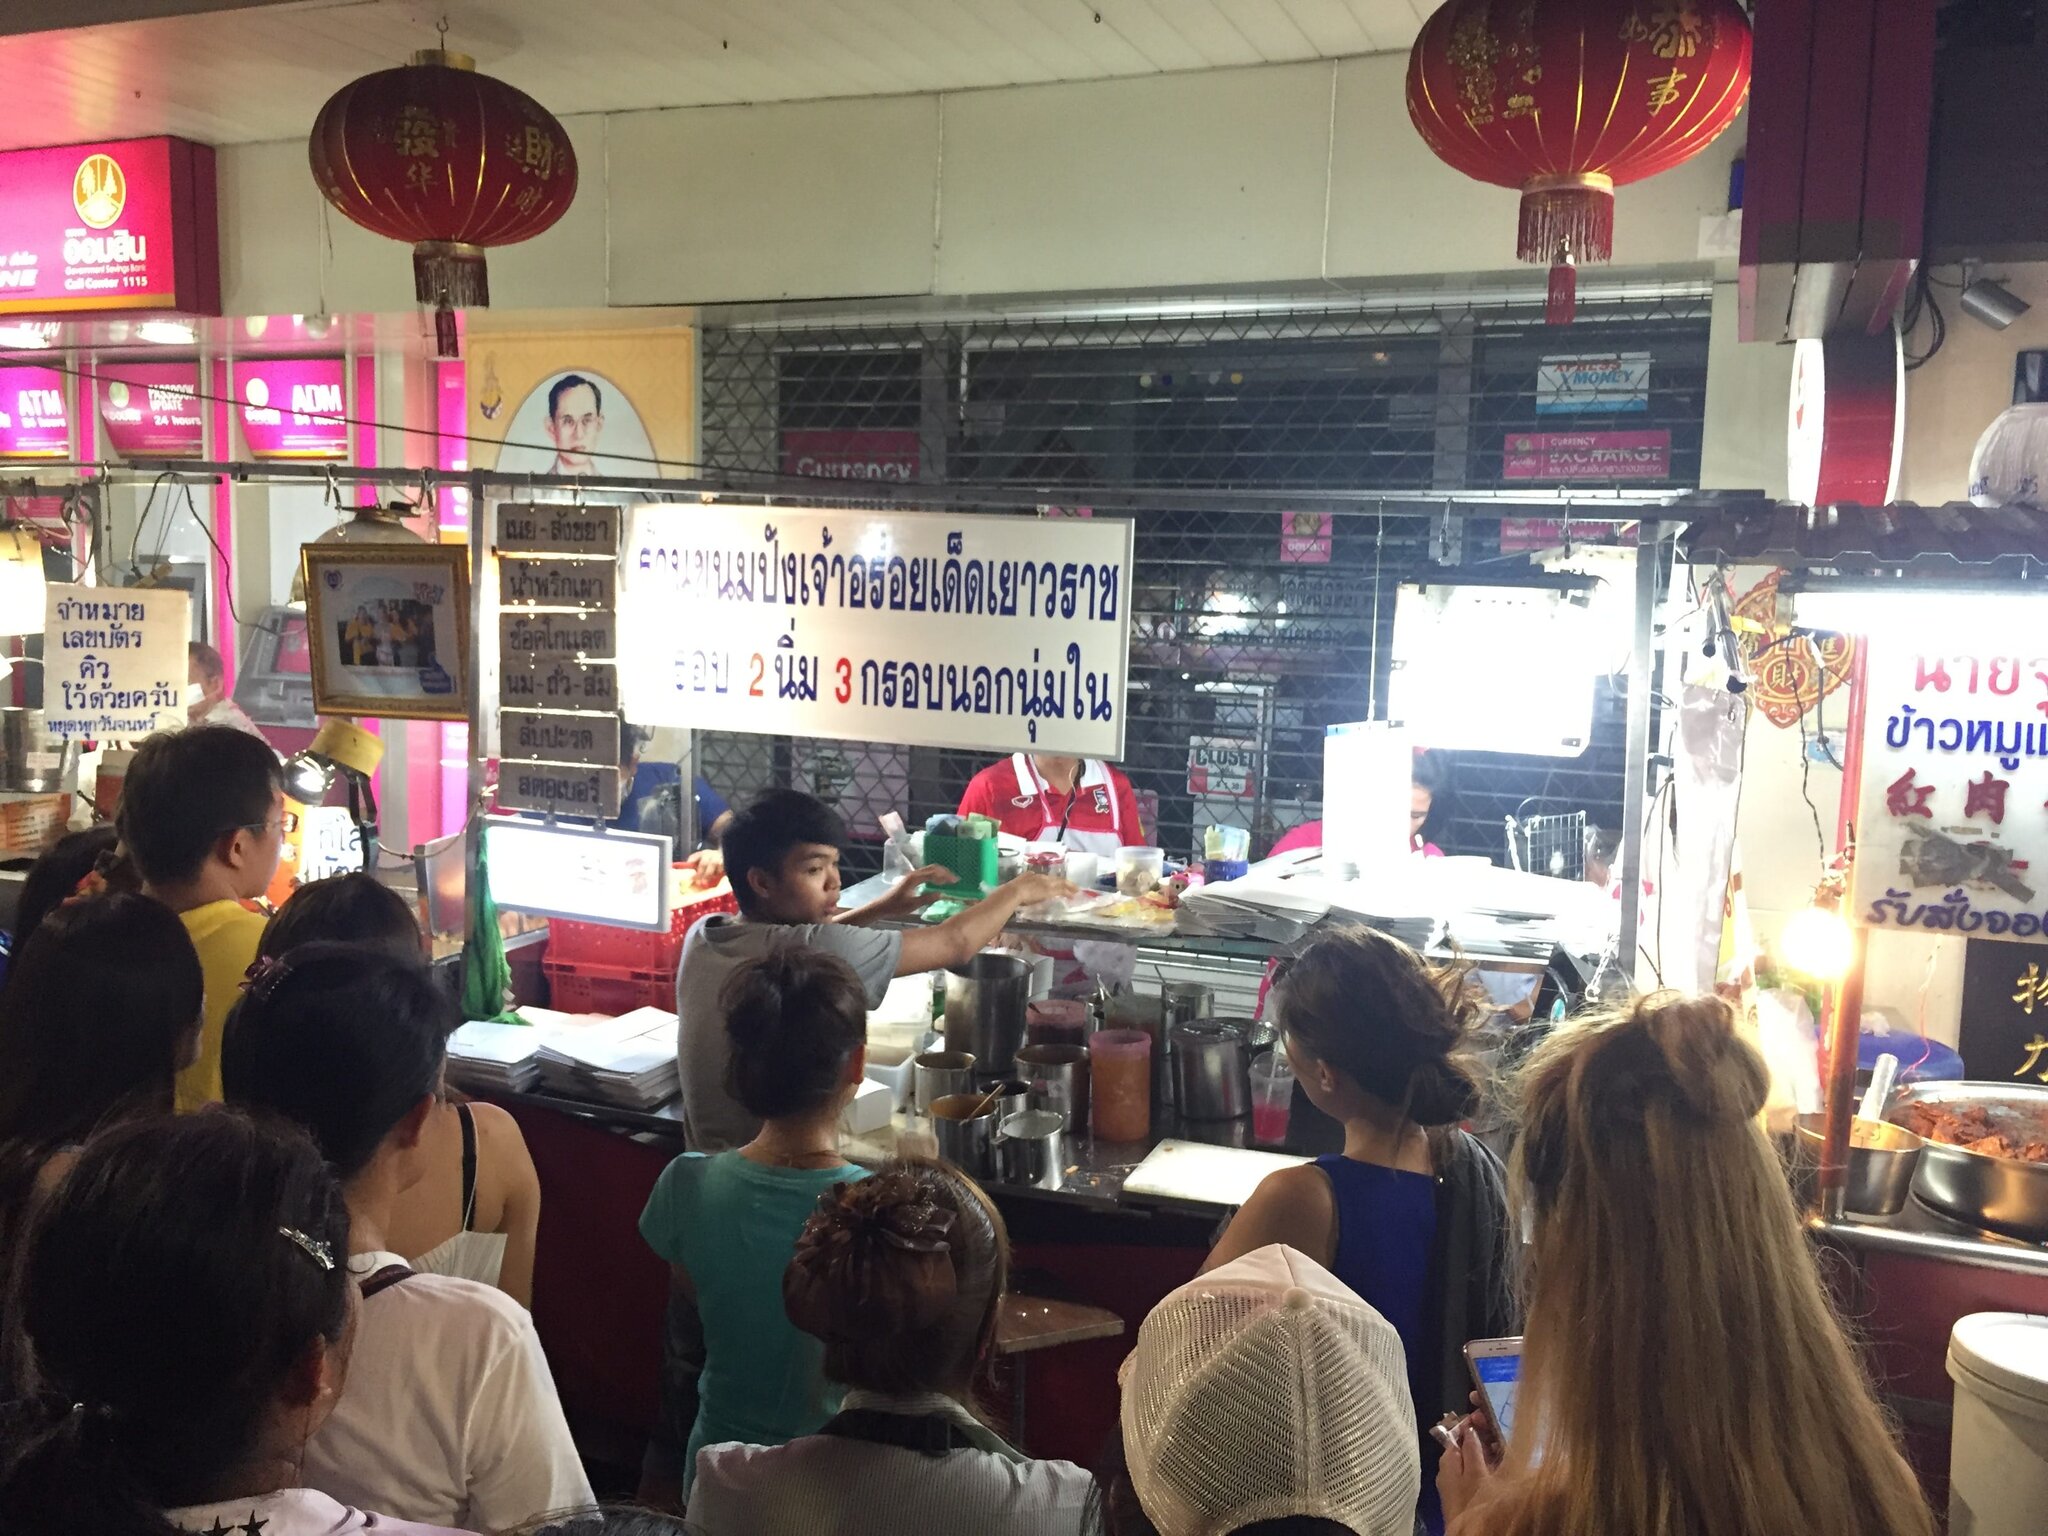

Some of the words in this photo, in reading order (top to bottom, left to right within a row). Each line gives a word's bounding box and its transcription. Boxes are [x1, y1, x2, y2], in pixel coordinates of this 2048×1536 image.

[64, 277, 85, 290] Call
[85, 277, 119, 289] Center
[123, 276, 148, 287] 1115
[18, 389, 63, 417] ATM
[292, 384, 344, 413] ADM
[154, 415, 169, 426] 24
[1550, 437, 1596, 447] CURRENCY
[62, 622, 143, 649] เลขบัตร
[79, 654, 110, 679] คิว
[749, 652, 765, 698] 2
[774, 617, 818, 702] นิ่ม
[835, 657, 852, 704] 3
[862, 641, 1112, 744] กรอบนอกนุ่มใน
[1867, 887, 2048, 937] รับสั่งจอ
